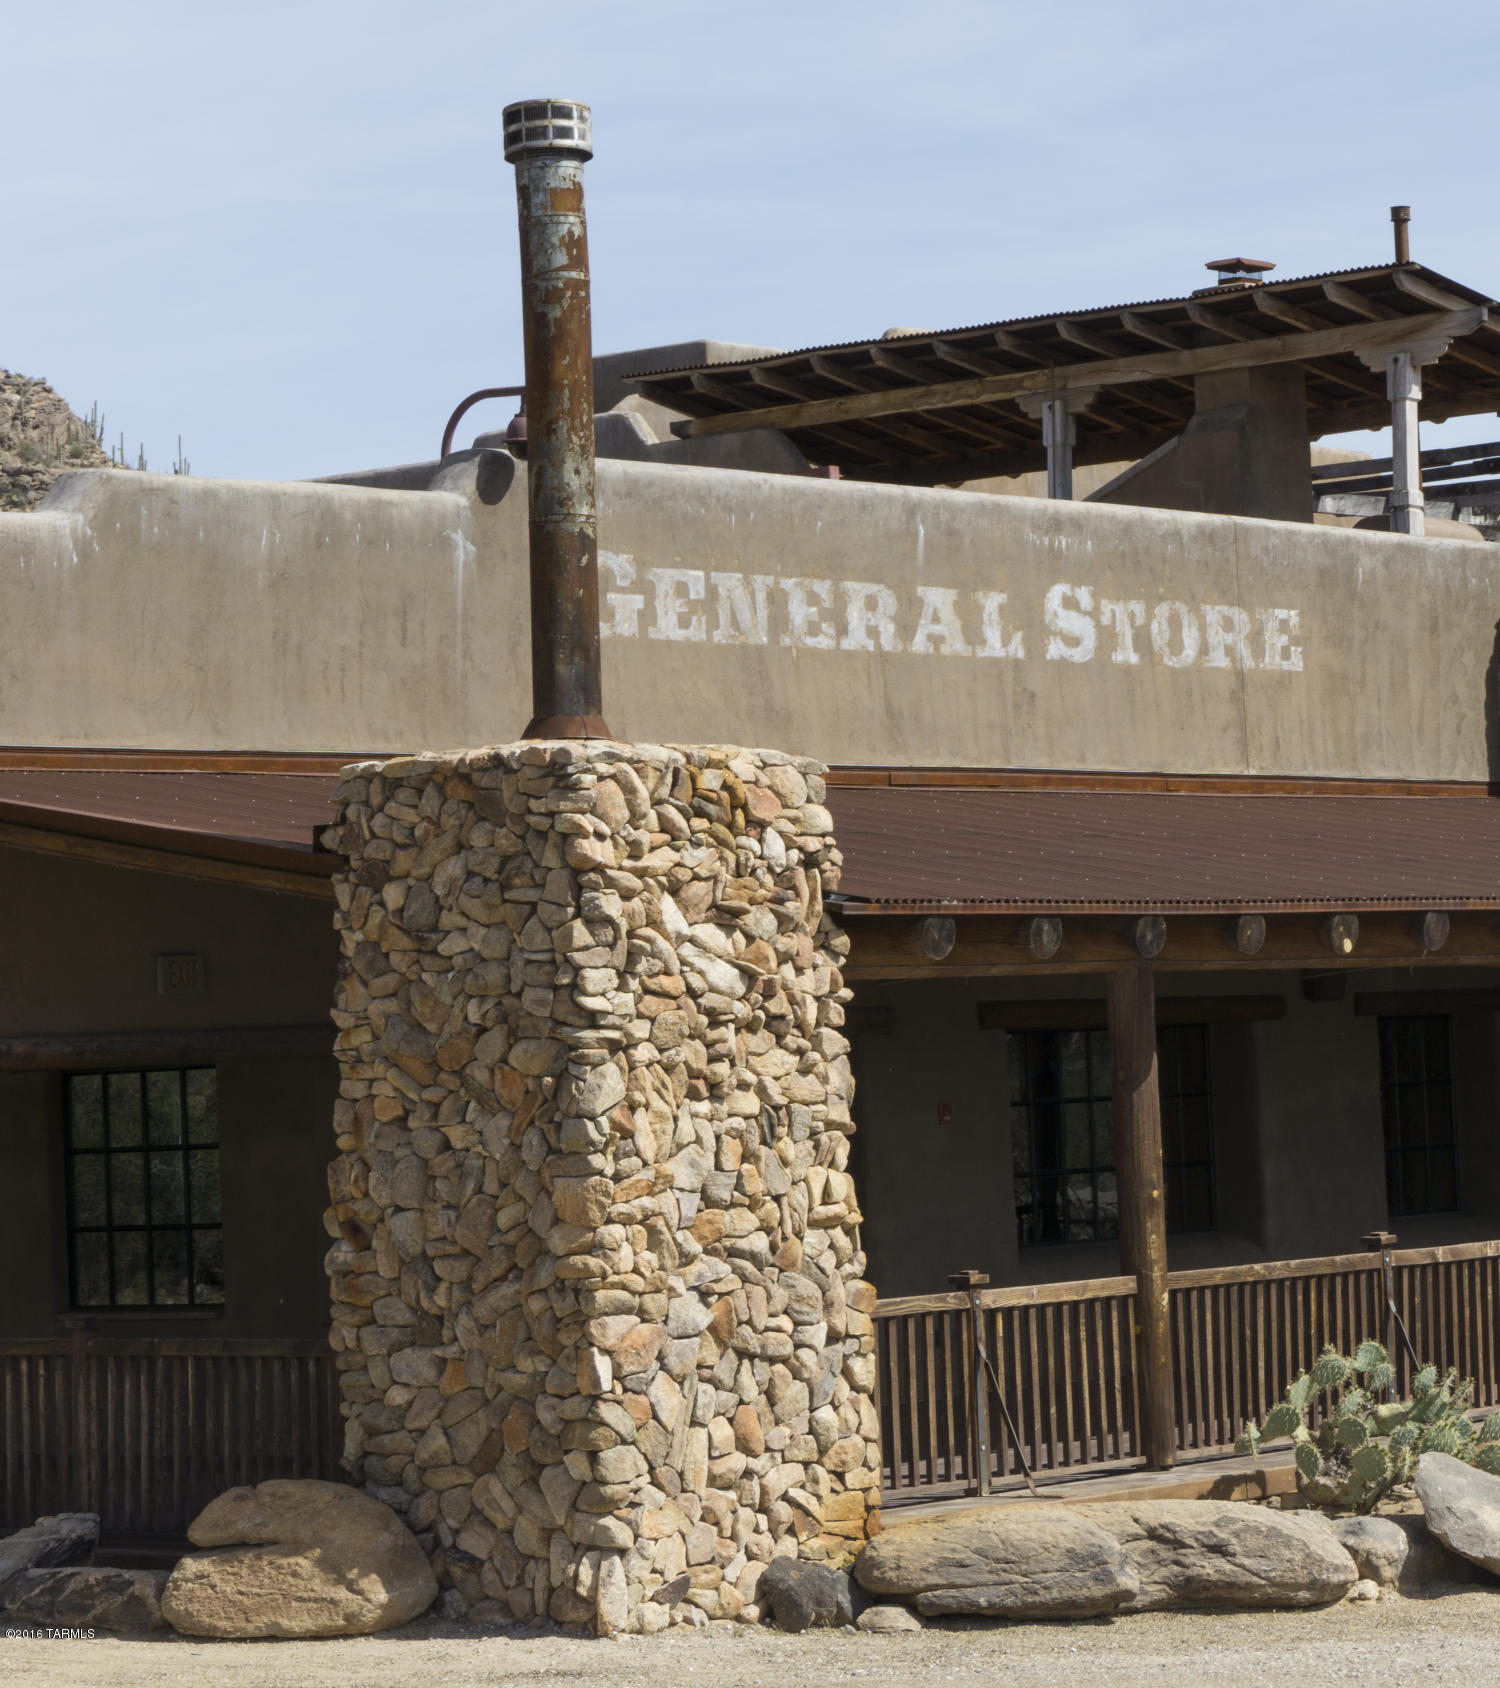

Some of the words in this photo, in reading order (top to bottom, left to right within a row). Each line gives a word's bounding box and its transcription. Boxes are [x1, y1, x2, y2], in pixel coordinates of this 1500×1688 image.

[598, 550, 1025, 660] GENERAL
[1044, 582, 1304, 671] STORE
[168, 960, 198, 989] EXIT
